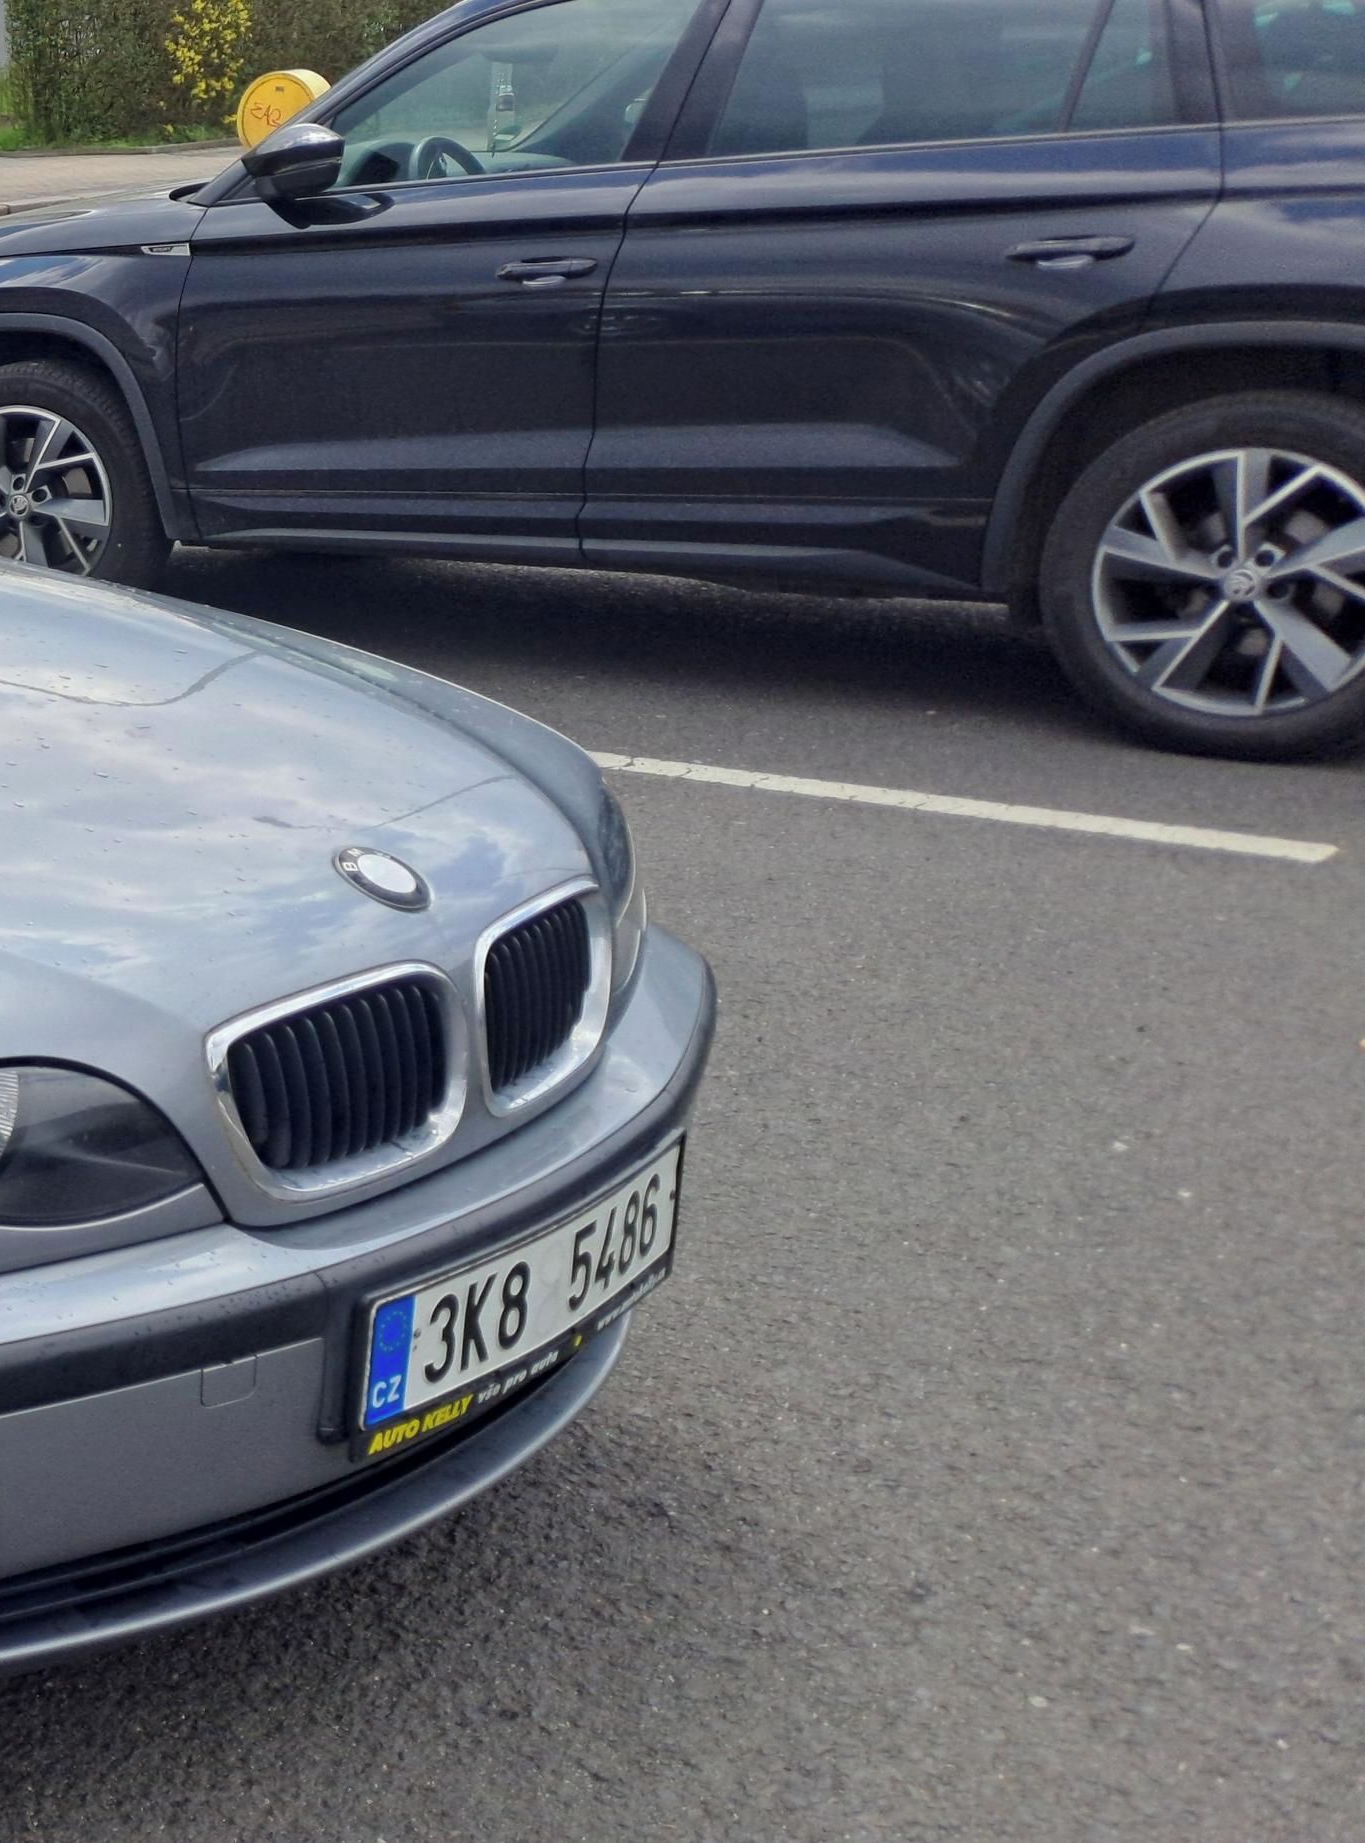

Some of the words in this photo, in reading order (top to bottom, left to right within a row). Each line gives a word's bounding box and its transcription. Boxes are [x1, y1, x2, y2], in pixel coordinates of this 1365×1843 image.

[424, 1261, 531, 1384] 3K8
[568, 1173, 661, 1312] 5486
[368, 1418, 420, 1455] AUTO
[422, 1393, 474, 1433] KELLY
[502, 1369, 527, 1395] pro
[530, 1350, 559, 1376] auto
[372, 1374, 402, 1408] CZ
